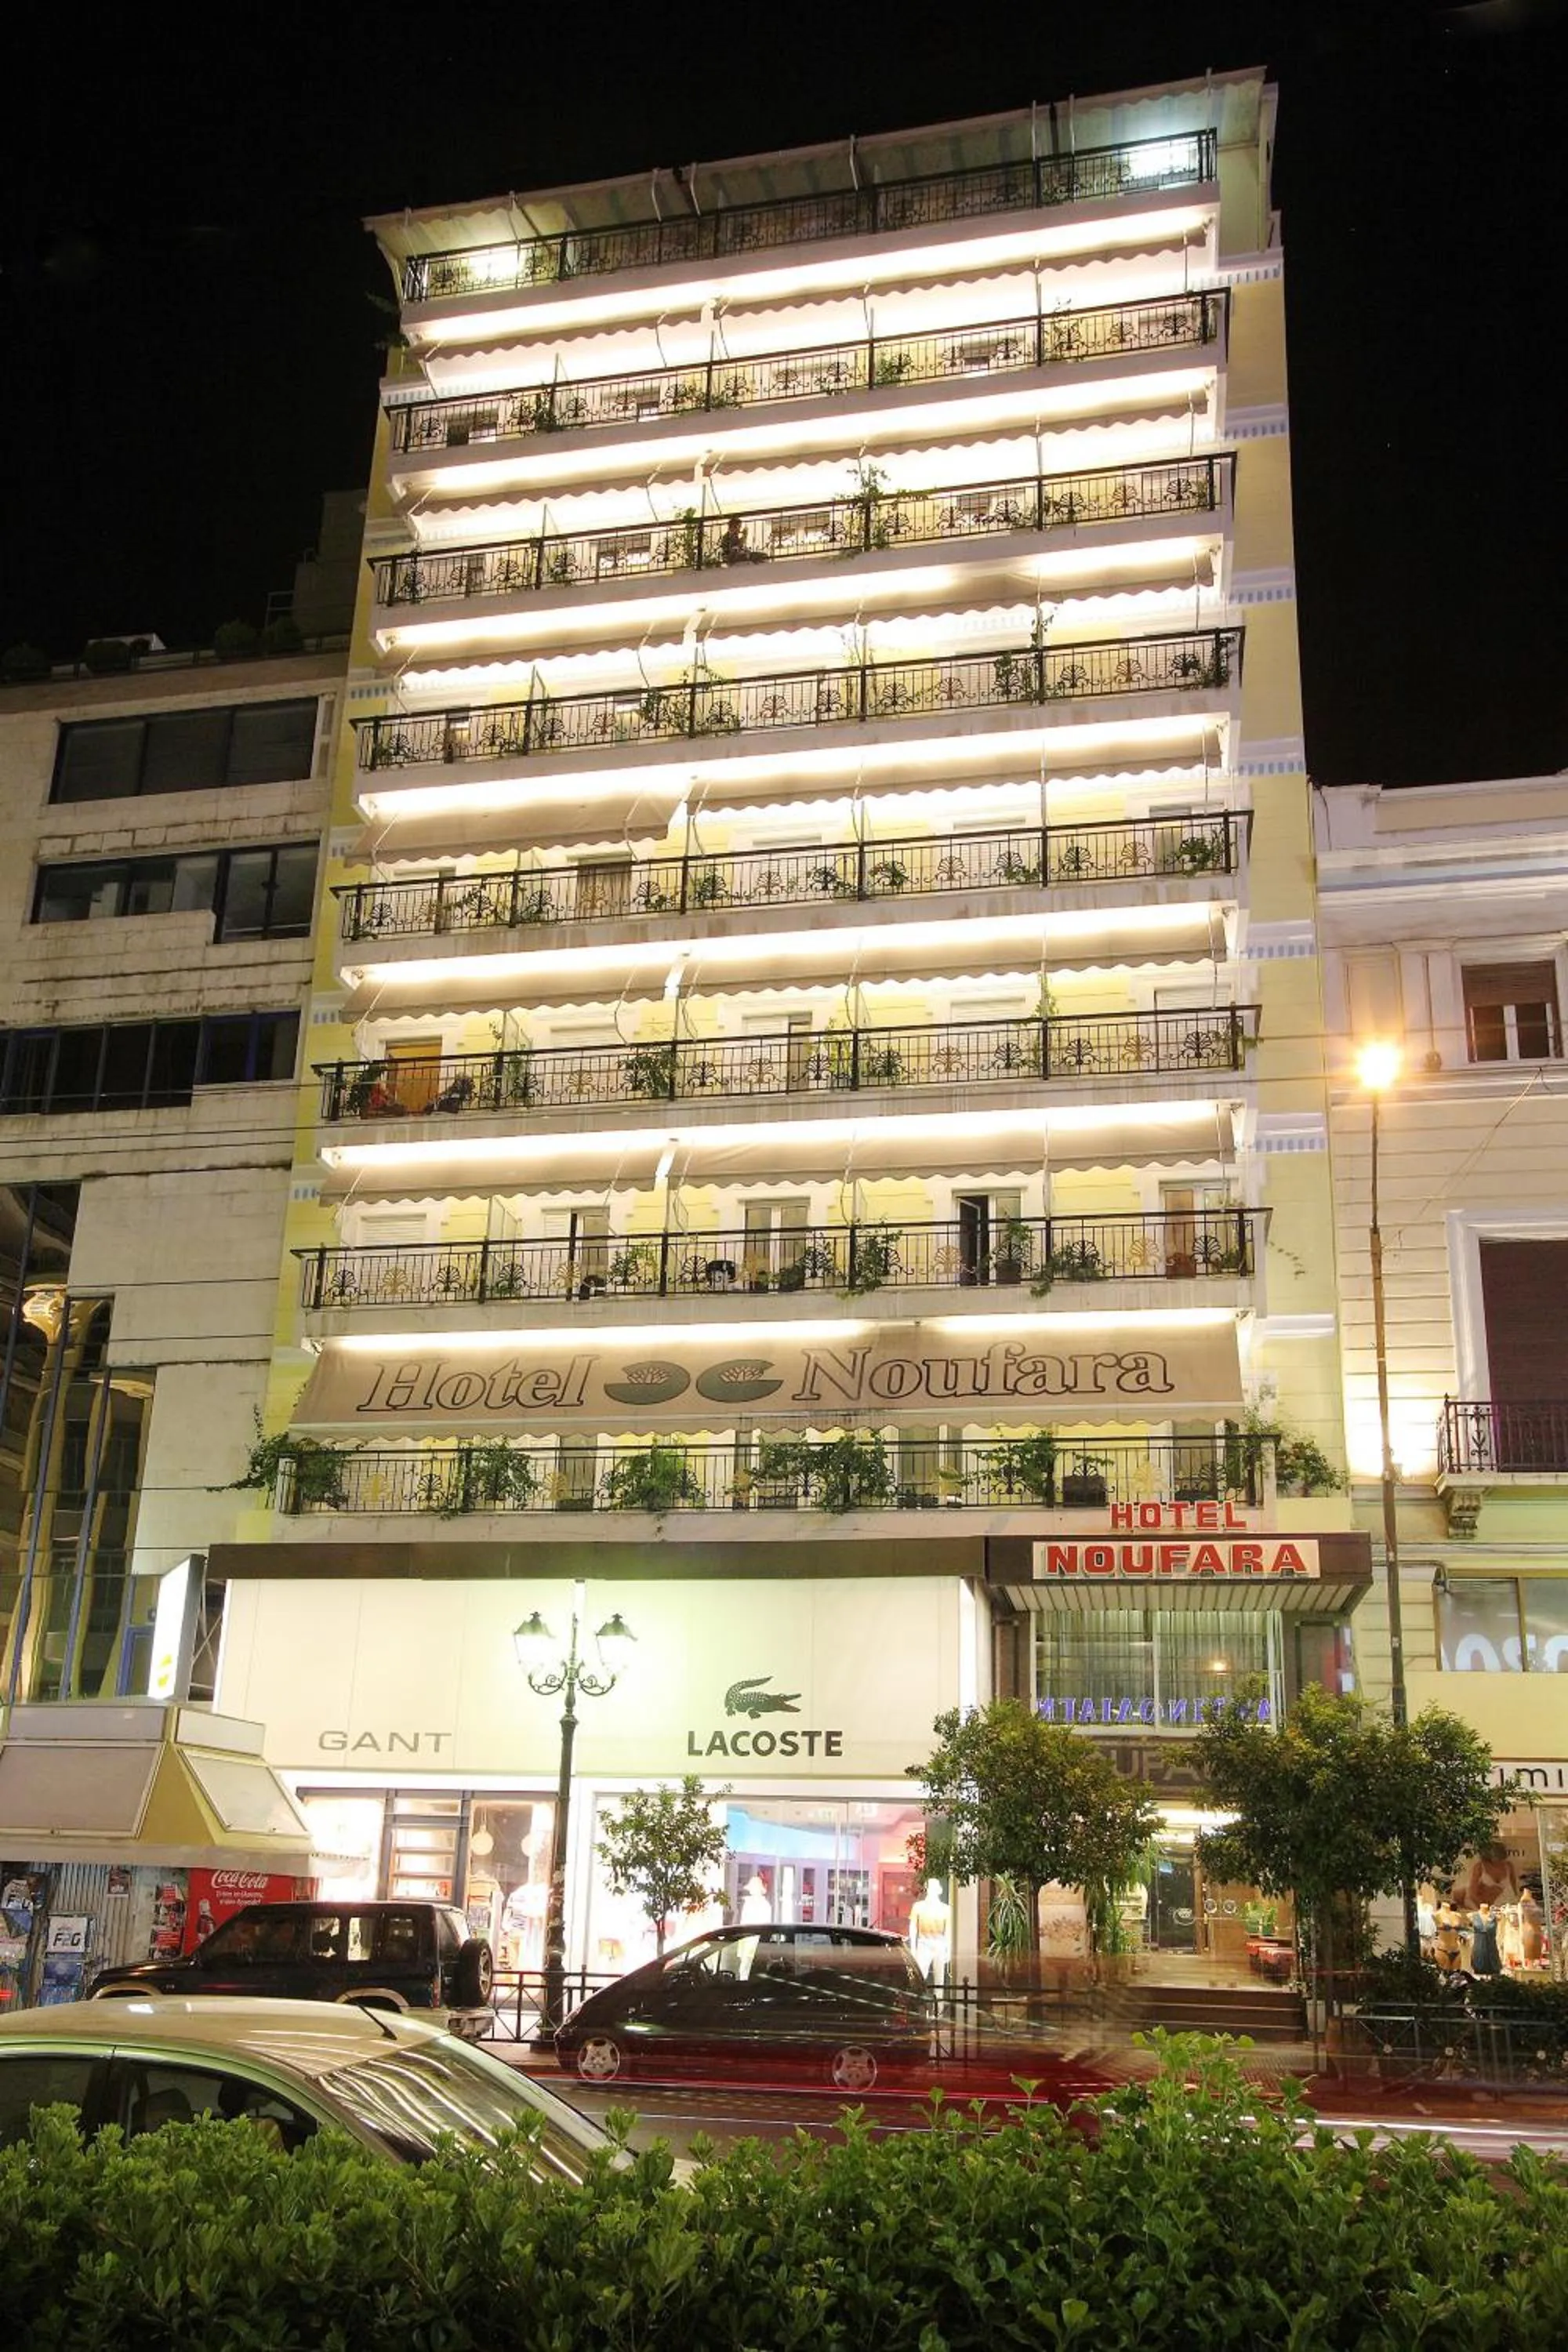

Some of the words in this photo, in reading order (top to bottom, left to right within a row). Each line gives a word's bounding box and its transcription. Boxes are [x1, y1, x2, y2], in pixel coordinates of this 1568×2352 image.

[356, 1353, 602, 1411] Hotel
[792, 1341, 1174, 1401] Noufara
[1110, 1501, 1248, 1530] HOTEL
[1046, 1543, 1308, 1573] NOUFARA
[318, 1730, 452, 1753] GANT
[687, 1730, 844, 1757] LACOSTE
